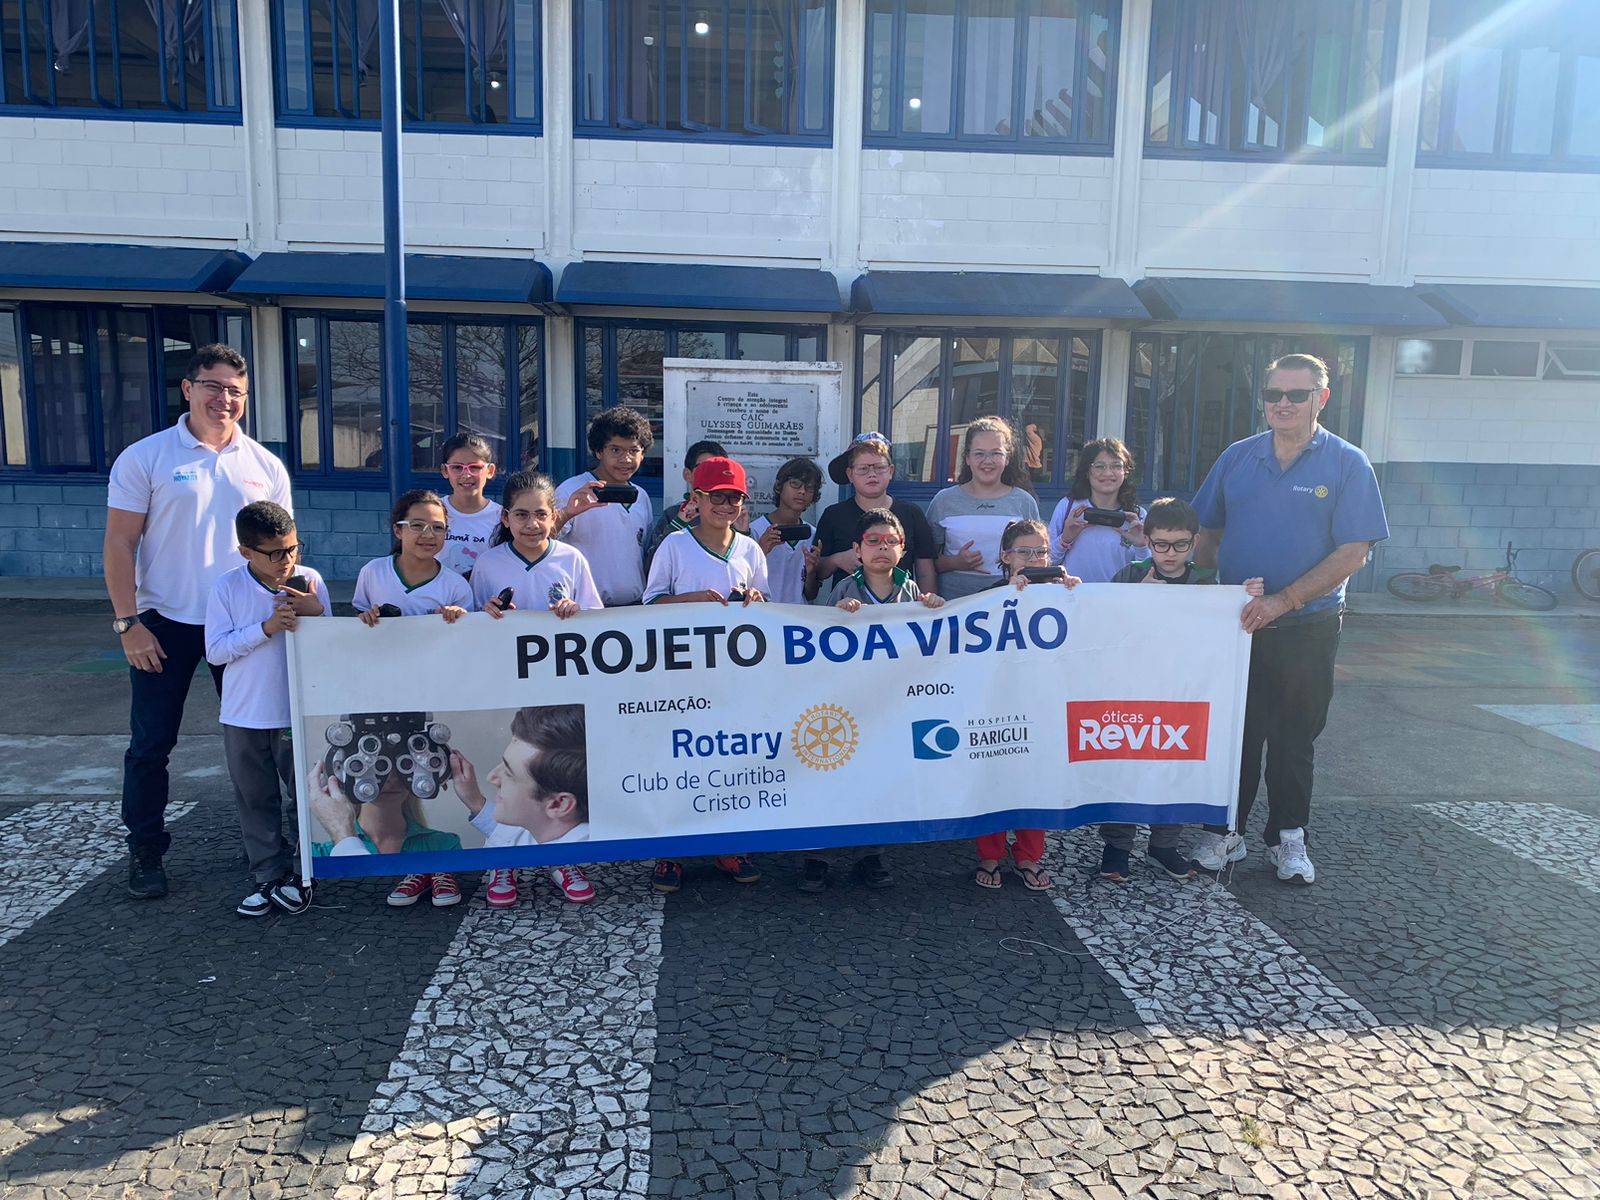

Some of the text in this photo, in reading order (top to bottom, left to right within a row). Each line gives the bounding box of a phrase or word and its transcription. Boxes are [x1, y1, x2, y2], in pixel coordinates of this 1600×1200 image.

[740, 413, 765, 422] CAIC
[700, 420, 805, 431] ULYSSES GUIMARÃES
[1292, 485, 1314, 494] Rotary
[516, 599, 1068, 679] PROJETO BOA VISÃO
[906, 682, 955, 697] APOIO:
[617, 695, 712, 714] REALIZAÇÃO:
[810, 711, 838, 720] ROTARY
[967, 714, 1028, 727] HOSPITAL
[1101, 710, 1144, 724] óticas
[969, 727, 1028, 747] BARIGUI
[1078, 715, 1191, 751] Revix
[671, 728, 783, 760] Rotary
[969, 746, 1030, 760] OFTALMOLOGIA
[621, 766, 787, 793] Club de Curitiba
[692, 788, 788, 813] Cristo Rei
